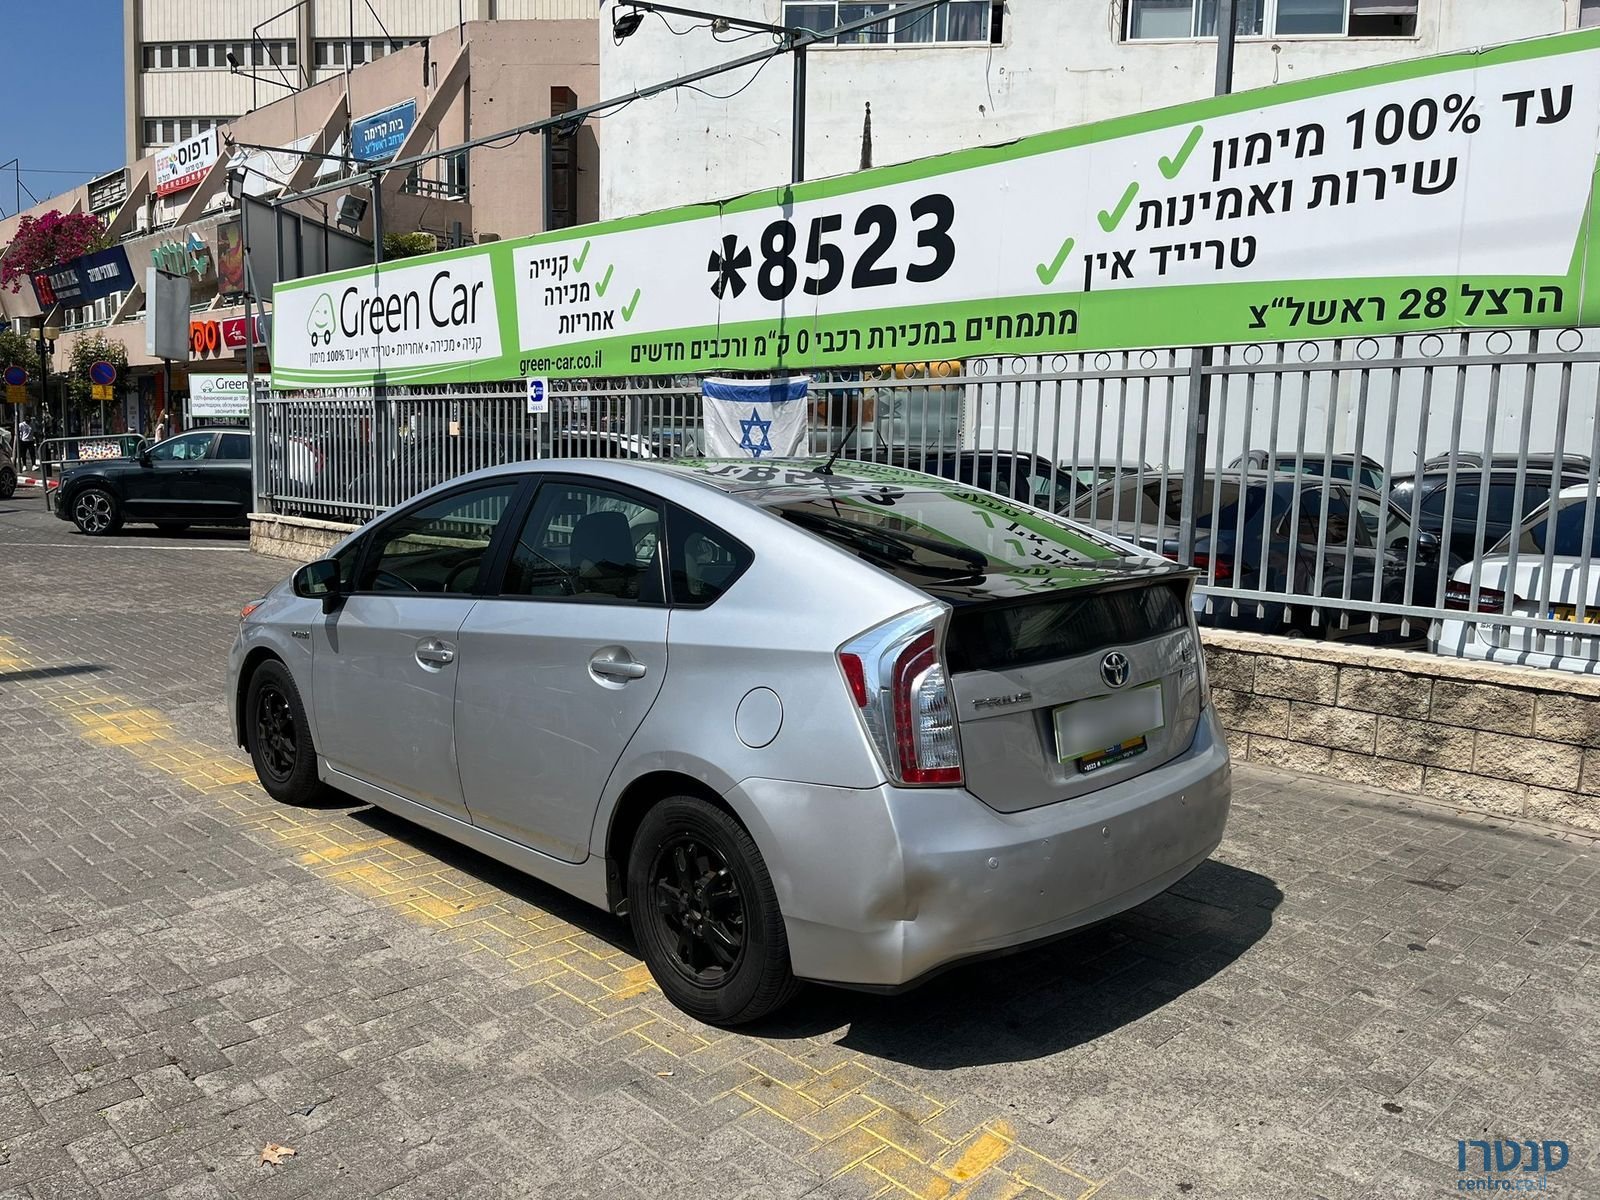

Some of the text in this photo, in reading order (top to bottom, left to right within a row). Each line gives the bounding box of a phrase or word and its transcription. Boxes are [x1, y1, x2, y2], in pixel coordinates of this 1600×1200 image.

[364, 119, 404, 142] בית קדימה
[1212, 84, 1574, 182] עד 100% מימון
[178, 137, 209, 166] דפוס
[1136, 156, 1458, 232] שירות ואמינות
[529, 254, 569, 281] קנייה
[1083, 235, 1257, 292] טרייד אין
[340, 270, 483, 338] Green Car
[544, 281, 590, 306] מכירה
[1398, 287, 1447, 320] 28
[1460, 284, 1564, 316] הרצל
[558, 310, 614, 334] אחריות
[965, 309, 1078, 341] מתמחים
[430, 339, 455, 353] מכירה
[462, 336, 482, 353] קניה
[691, 336, 747, 360] ורכבים
[797, 328, 809, 354] 0
[815, 328, 861, 353] רכבי
[867, 321, 957, 350] במכירת
[327, 350, 345, 362] 100%
[359, 347, 369, 362] אין
[396, 342, 424, 356] אחריות
[630, 342, 685, 363] חדשים
[520, 350, 602, 376] green-car.co.il
[216, 378, 249, 389] Green
